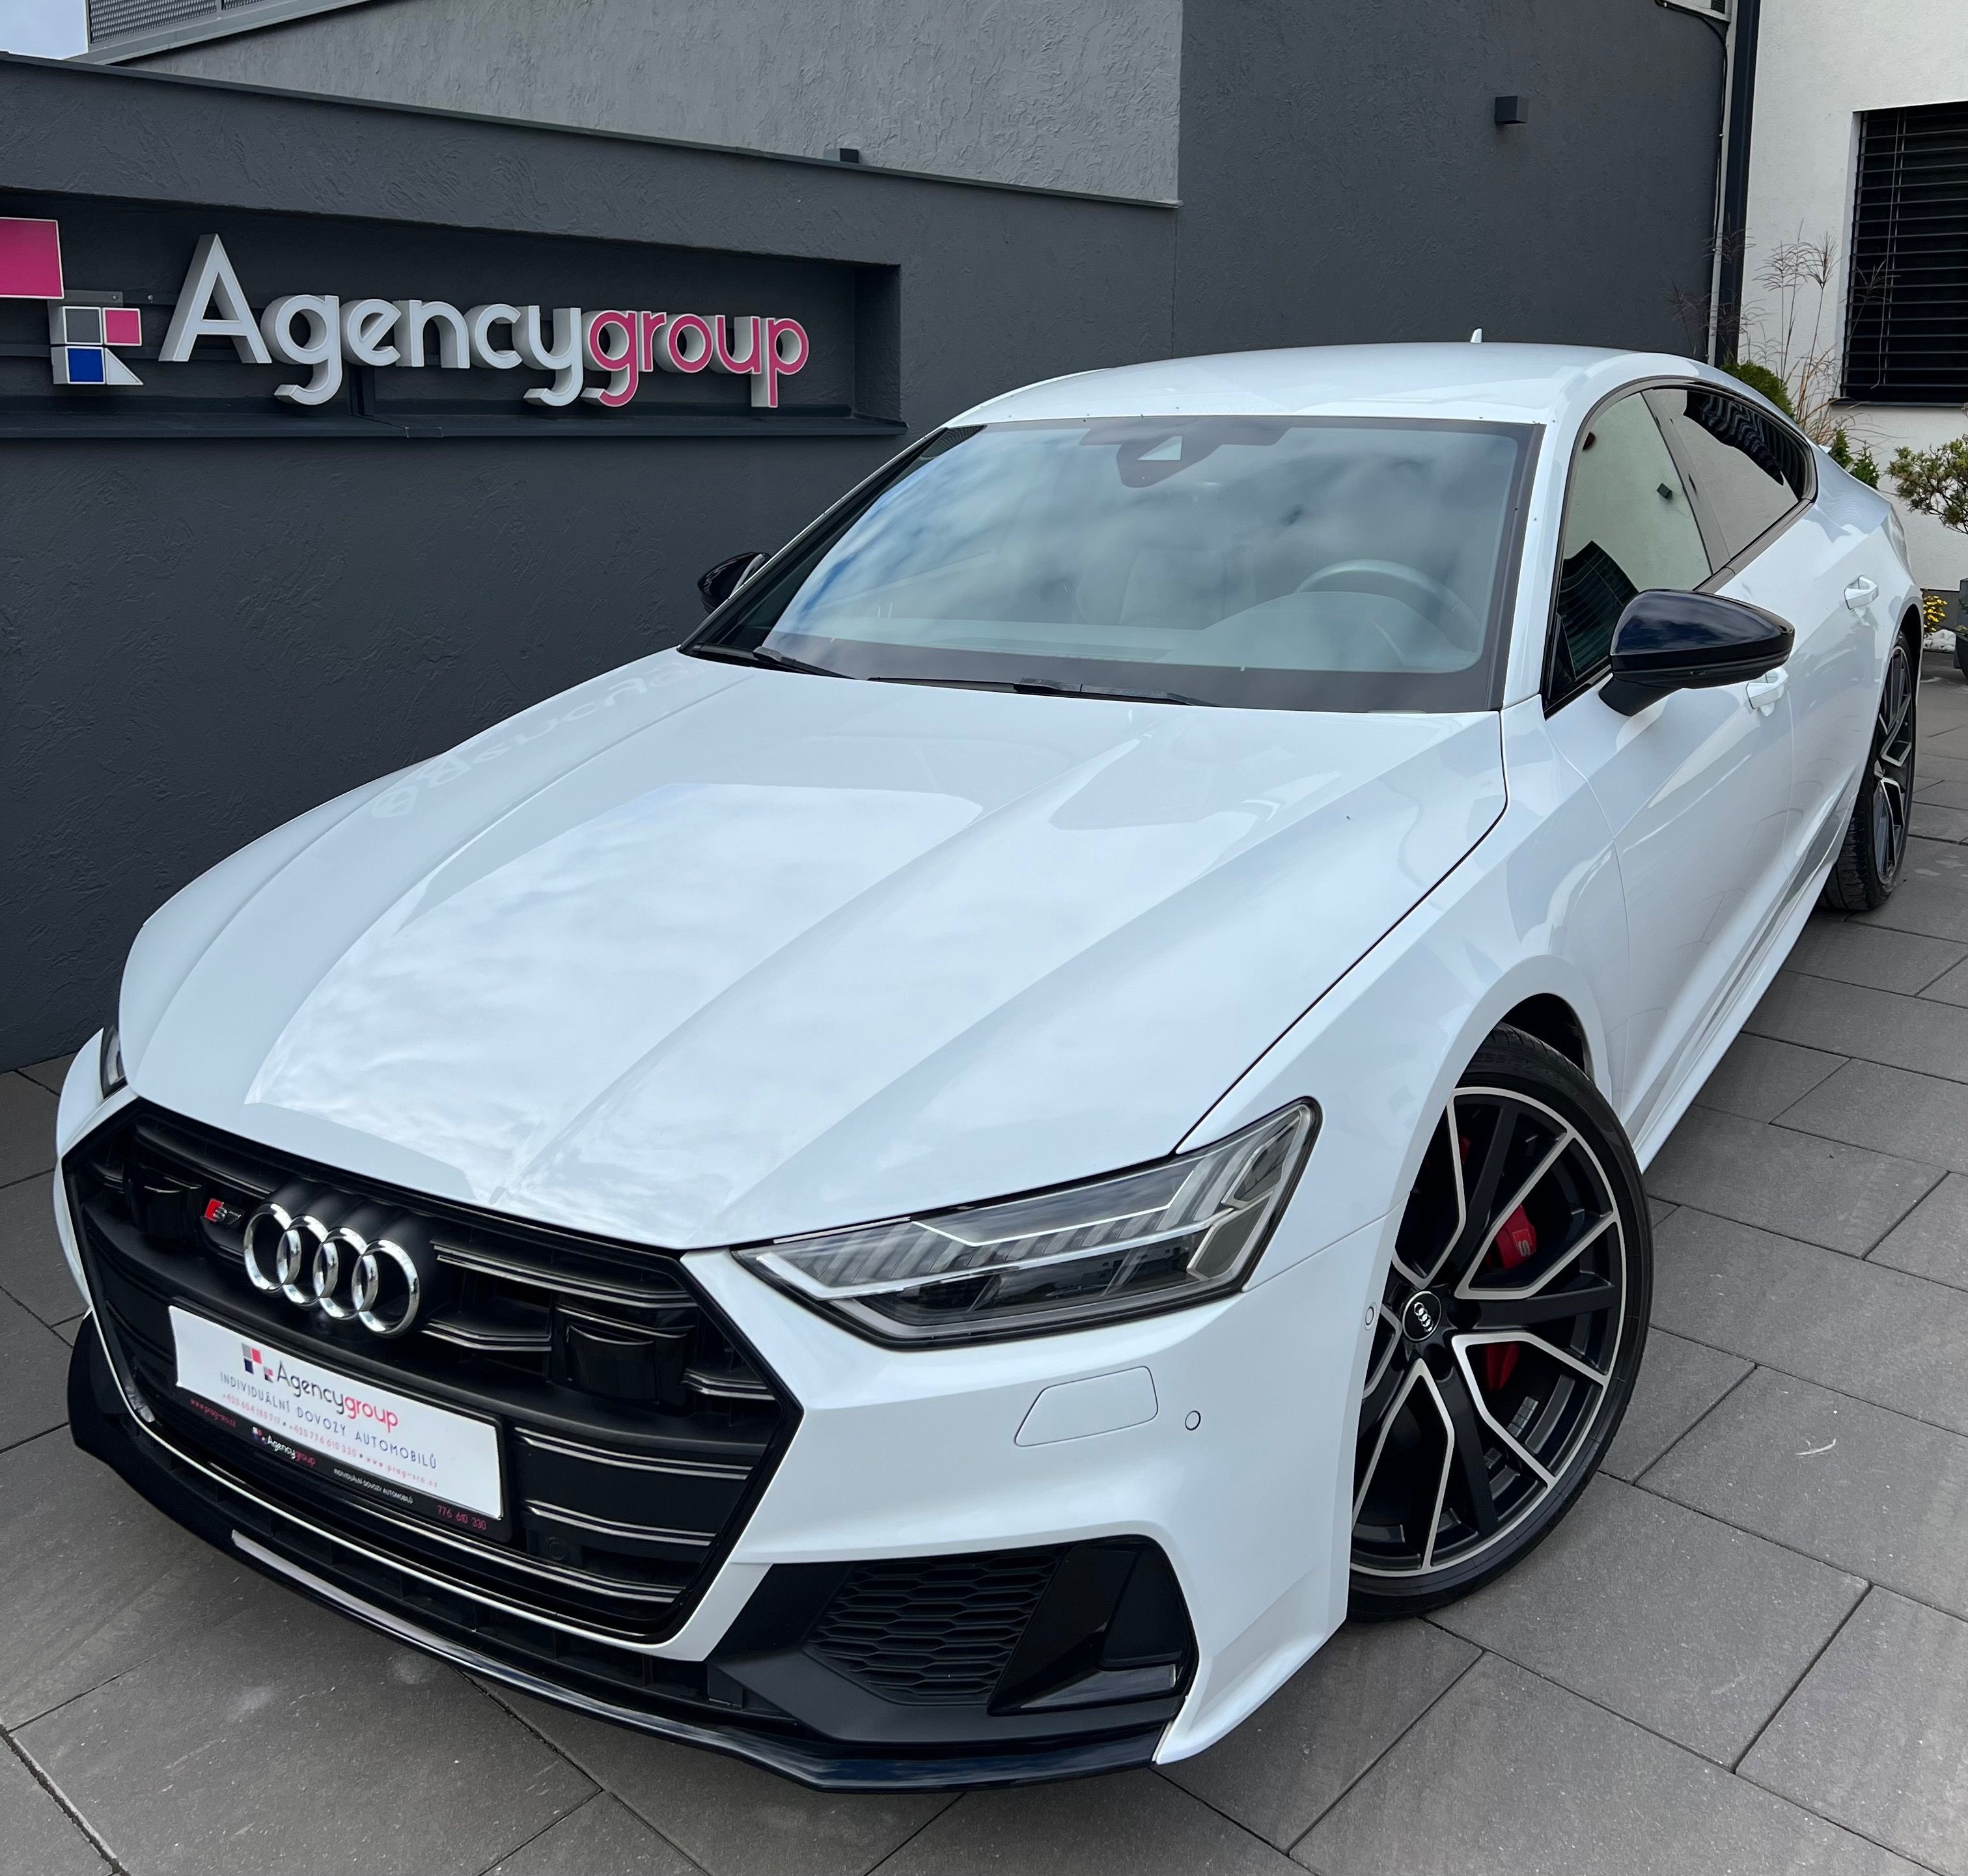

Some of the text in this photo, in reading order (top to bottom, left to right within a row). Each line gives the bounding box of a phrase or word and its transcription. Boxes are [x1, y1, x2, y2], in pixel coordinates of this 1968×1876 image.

[158, 234, 809, 408] Agencygroup
[220, 1371, 437, 1469] INDIVIDUÁLNÍ DOVOZY AUTOMOBILŮ
[277, 1360, 398, 1433] Agencygroup
[437, 1504, 487, 1531] 776 610 330
